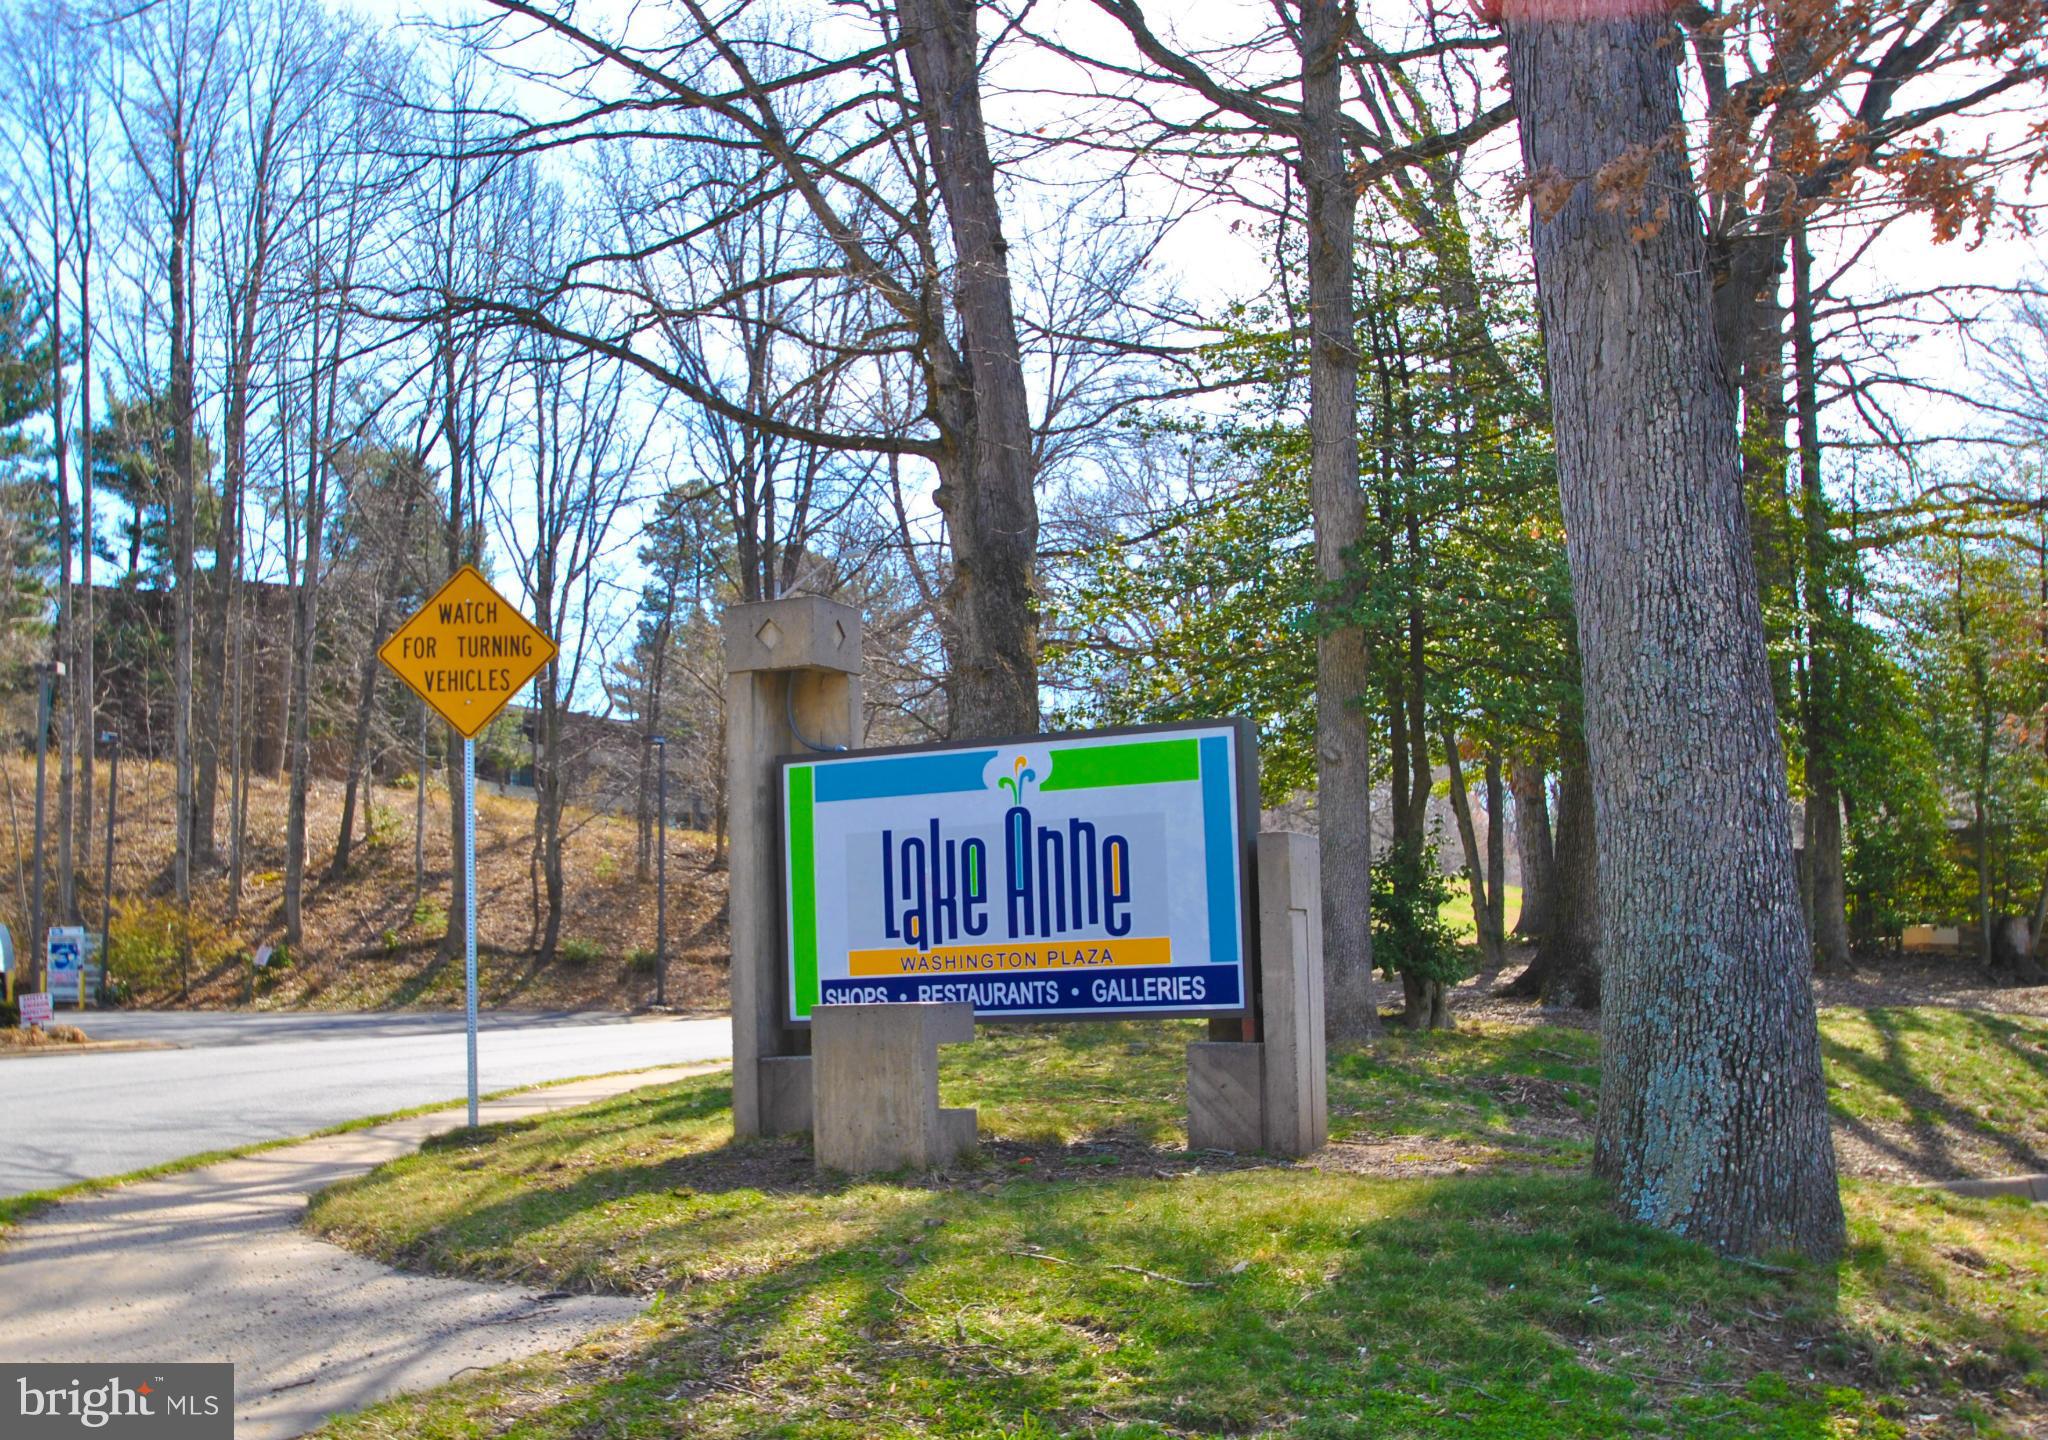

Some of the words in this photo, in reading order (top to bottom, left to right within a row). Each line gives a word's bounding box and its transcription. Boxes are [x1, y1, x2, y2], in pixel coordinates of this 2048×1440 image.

[438, 602, 497, 624] WATCH
[403, 637, 436, 659] FOR
[457, 635, 532, 657] TURNING
[424, 669, 510, 692] VEHICLES
[882, 818, 988, 951] Lake
[1005, 806, 1132, 938] Anne
[900, 952, 1037, 972] WASHINGTON
[1047, 948, 1114, 966] PLAZA
[825, 987, 888, 1004] SHOPS
[918, 981, 1059, 1005] RESTAURANTS
[1091, 976, 1206, 1002] GALLERIES
